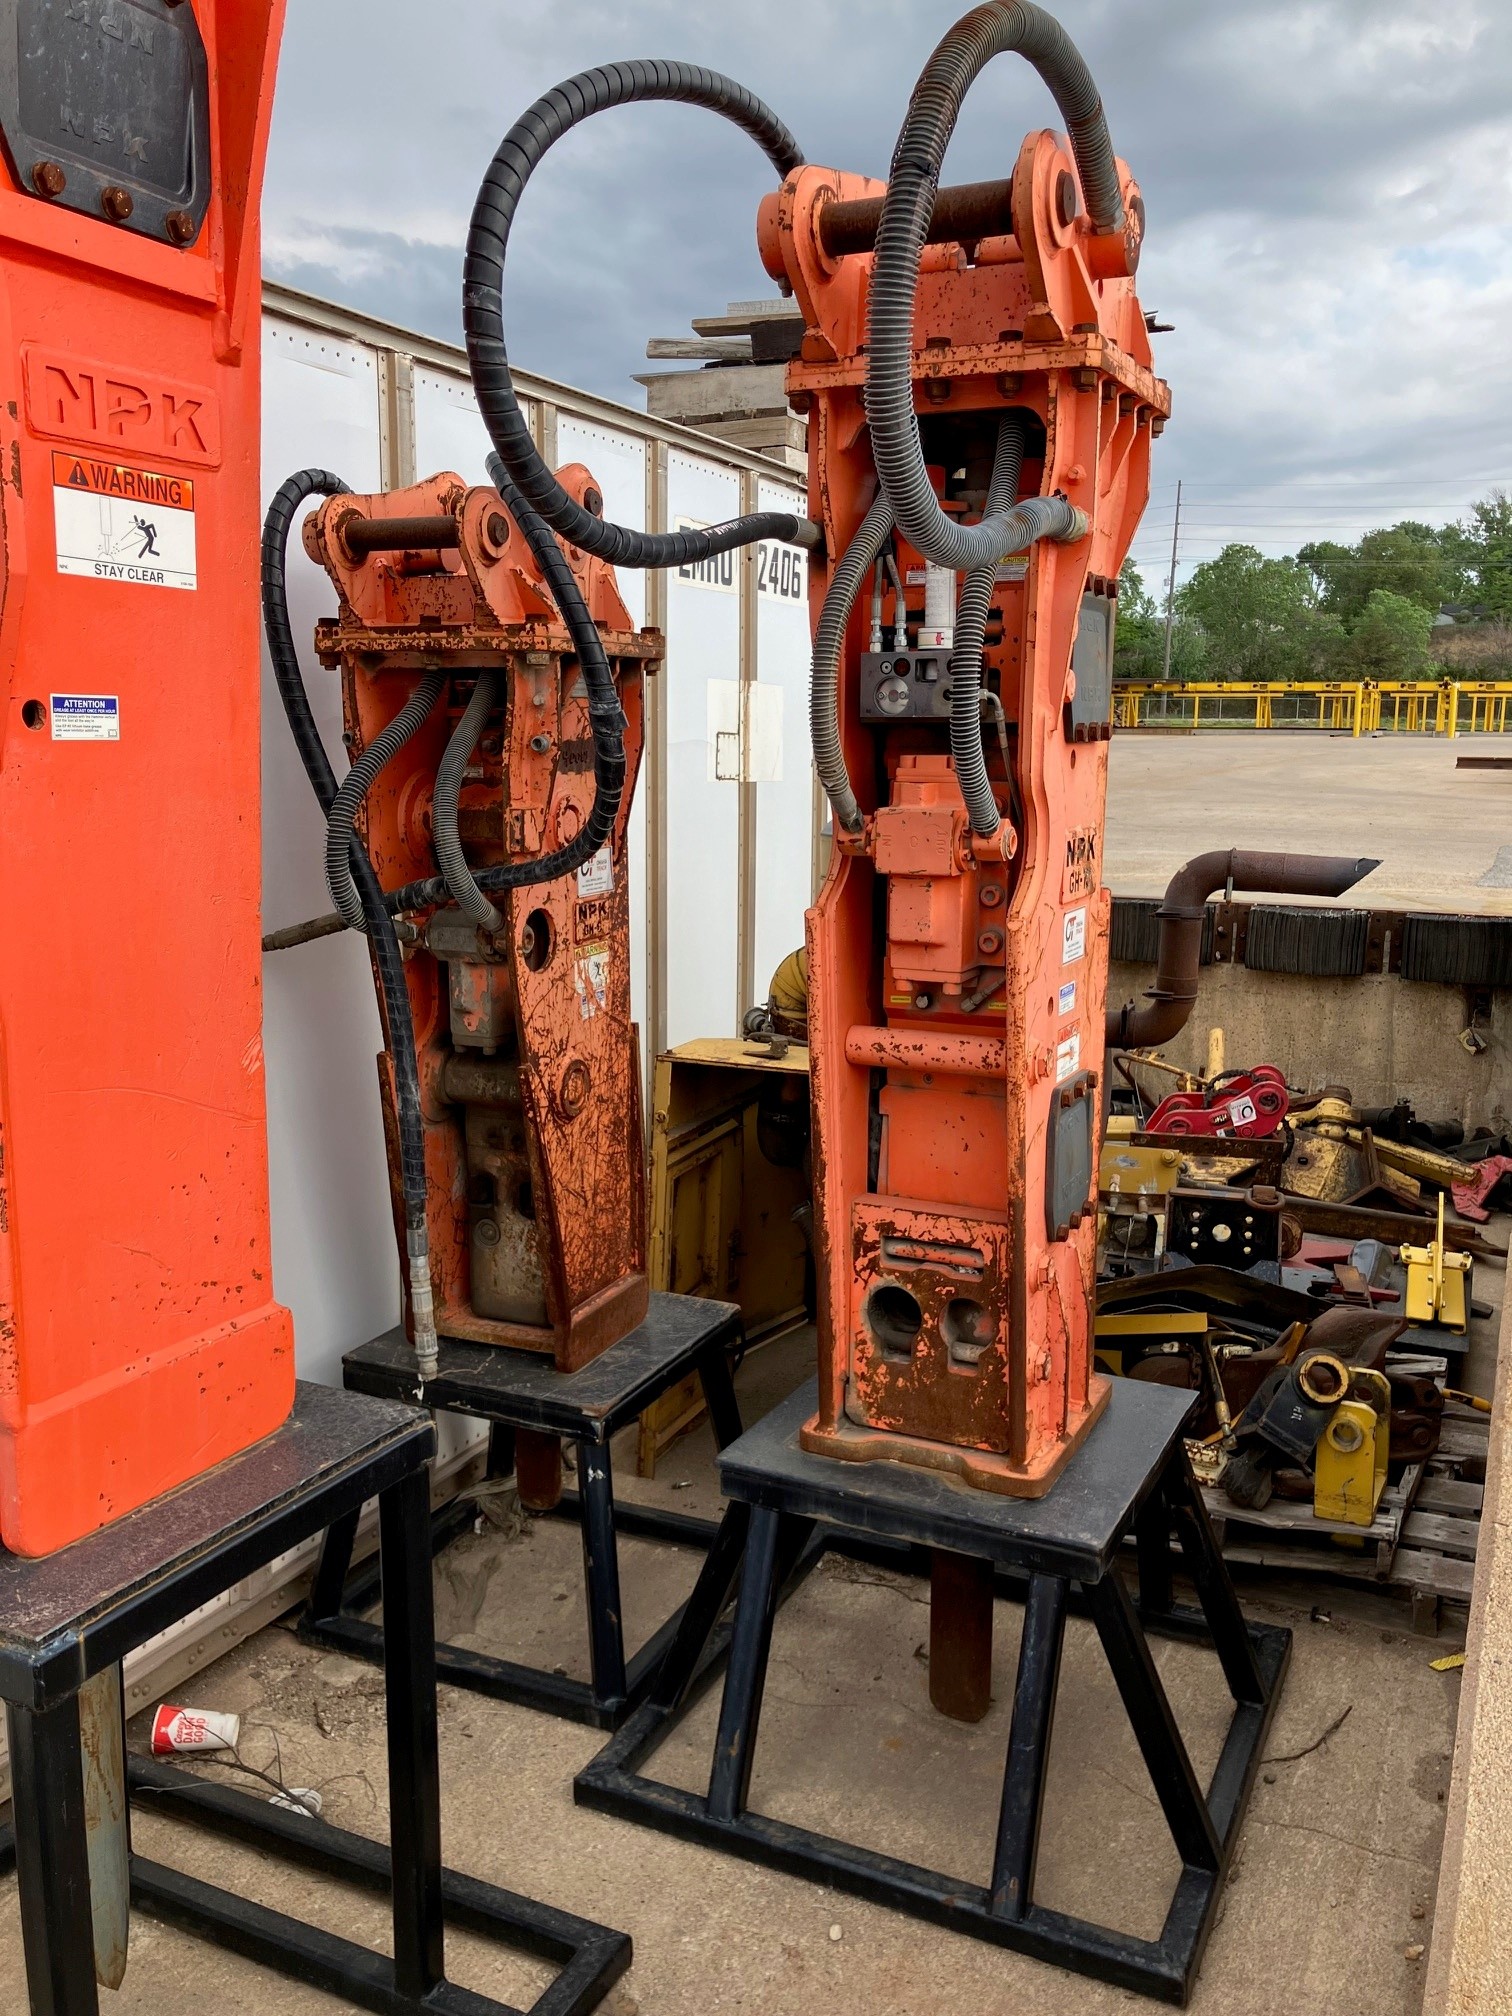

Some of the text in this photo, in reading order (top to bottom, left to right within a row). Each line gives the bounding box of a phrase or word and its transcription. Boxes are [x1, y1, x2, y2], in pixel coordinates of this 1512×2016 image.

[45, 365, 207, 453] NPK
[90, 463, 182, 505] WARNING
[94, 563, 164, 584] STAY CLEAR
[758, 543, 808, 599] 2406
[64, 700, 106, 708] ATTENTION
[578, 900, 608, 920] NPK
[183, 1716, 195, 1744] DARN
[193, 1717, 206, 1744] GOOD
